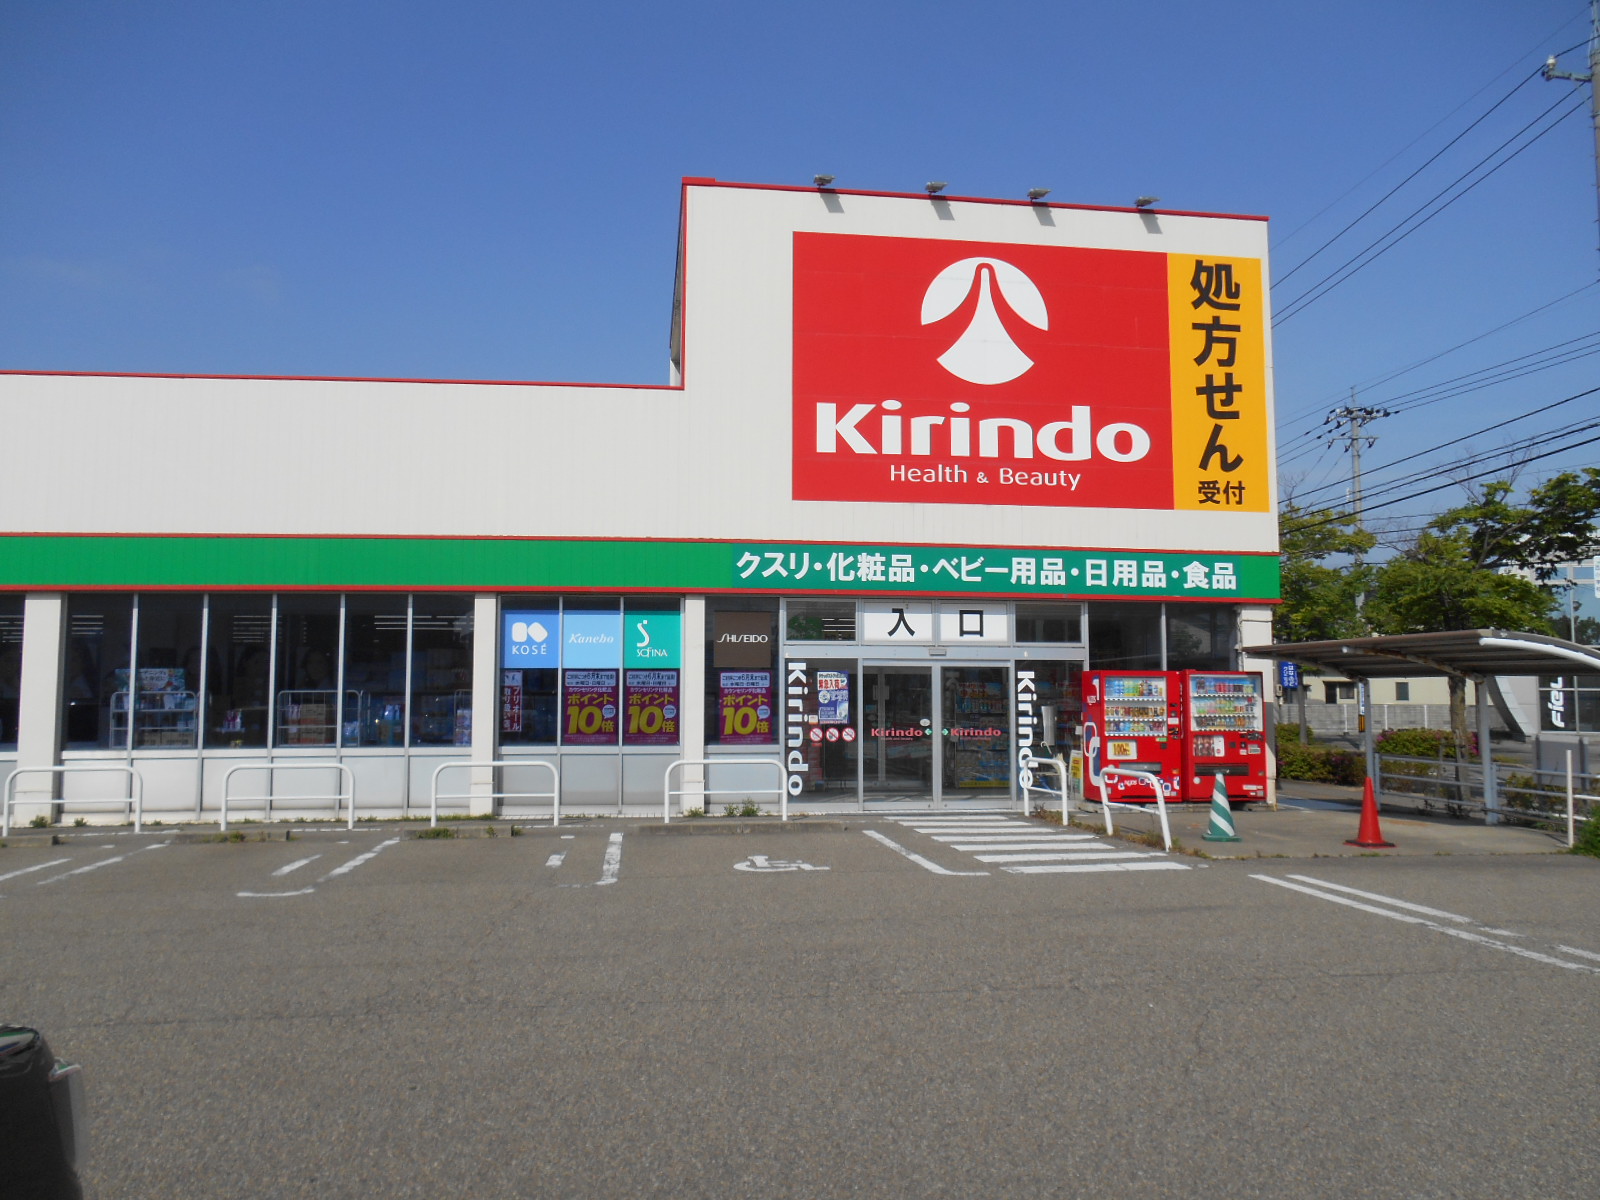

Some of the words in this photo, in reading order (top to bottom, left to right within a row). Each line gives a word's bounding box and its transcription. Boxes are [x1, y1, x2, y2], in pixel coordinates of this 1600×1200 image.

[1190, 259, 1244, 474] 処方せん
[816, 399, 1151, 463] Kirindo
[890, 464, 968, 484] Health
[976, 471, 989, 484] &
[999, 467, 1081, 491] Beauty
[1198, 480, 1246, 506] 受付
[736, 551, 1237, 591] クスリ・化粧品・ベビー用品・日用品・食品
[568, 633, 615, 644] Kanebo
[717, 633, 768, 643] SHISEIDO
[512, 643, 547, 655] KOSÉ
[636, 647, 668, 658] SOFINA
[568, 693, 615, 705] ポイント
[628, 693, 675, 705] ポイント
[723, 694, 769, 706] ポイント
[788, 662, 809, 796] Kirindo
[871, 728, 923, 737] Kirindo
[950, 728, 1002, 737] Kirindo
[1017, 671, 1039, 789] Kirindo
